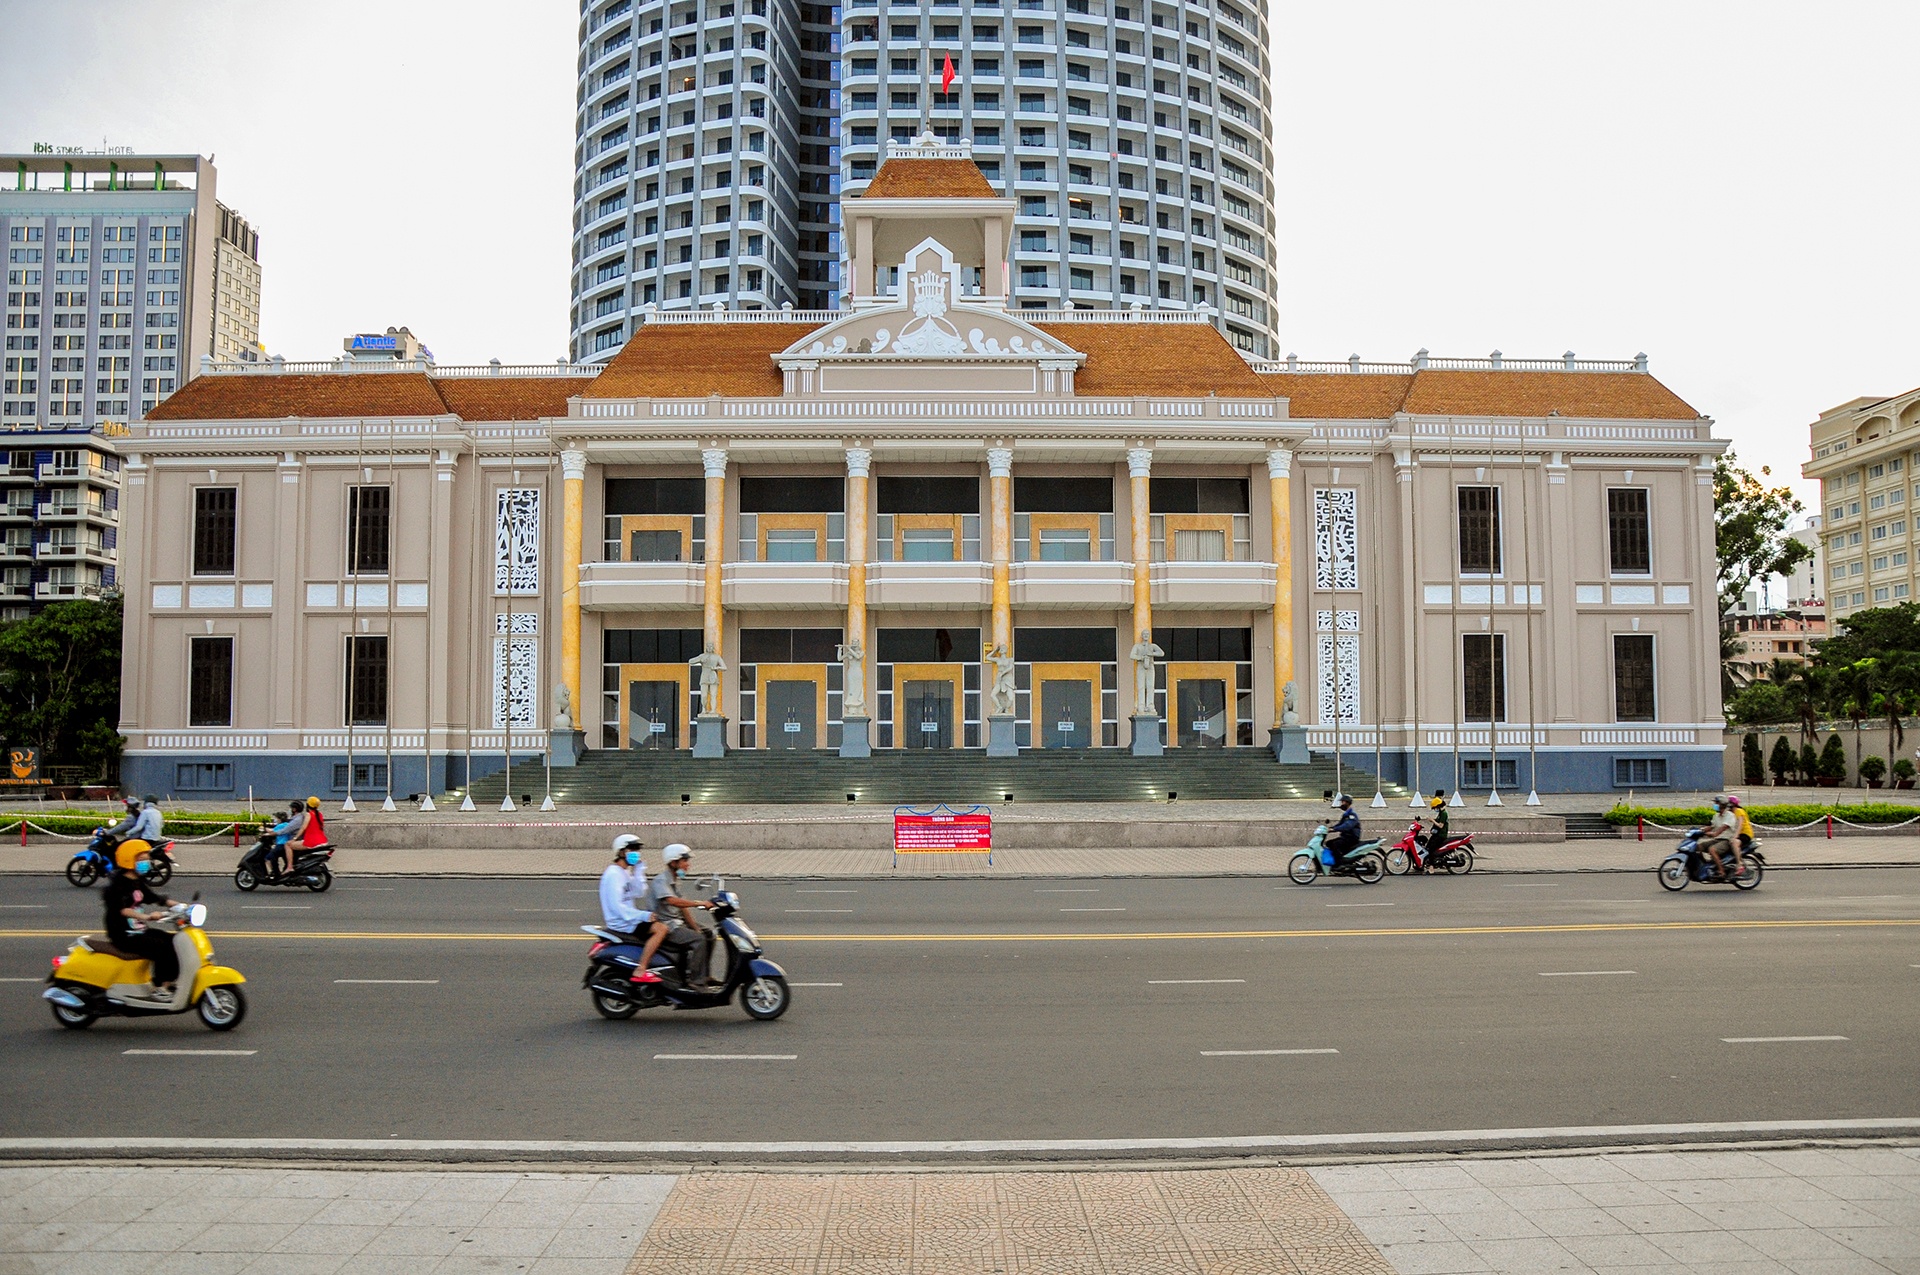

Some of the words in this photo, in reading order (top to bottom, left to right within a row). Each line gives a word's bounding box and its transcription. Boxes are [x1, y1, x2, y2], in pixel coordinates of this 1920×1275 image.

[33, 142, 53, 153] ibis
[56, 146, 84, 154] STYLES
[108, 146, 135, 154] HOTEL
[351, 336, 397, 349] Atlantic
